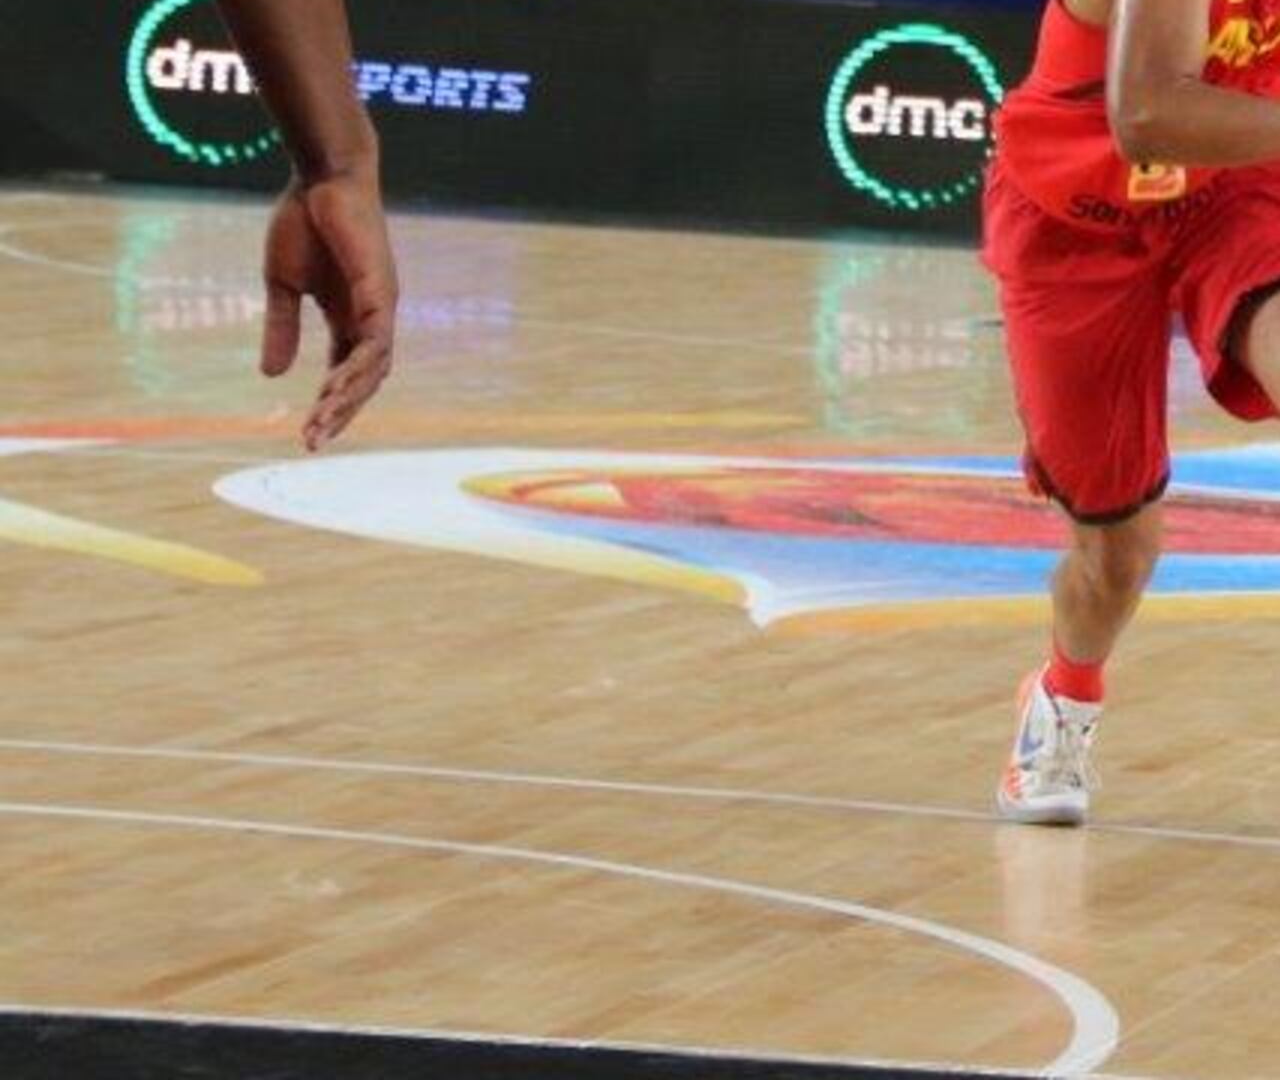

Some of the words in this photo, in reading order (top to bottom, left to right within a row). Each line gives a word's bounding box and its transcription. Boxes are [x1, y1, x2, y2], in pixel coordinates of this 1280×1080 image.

[145, 38, 252, 95] dm
[350, 61, 531, 112] PORTS
[845, 85, 985, 140] dmc
